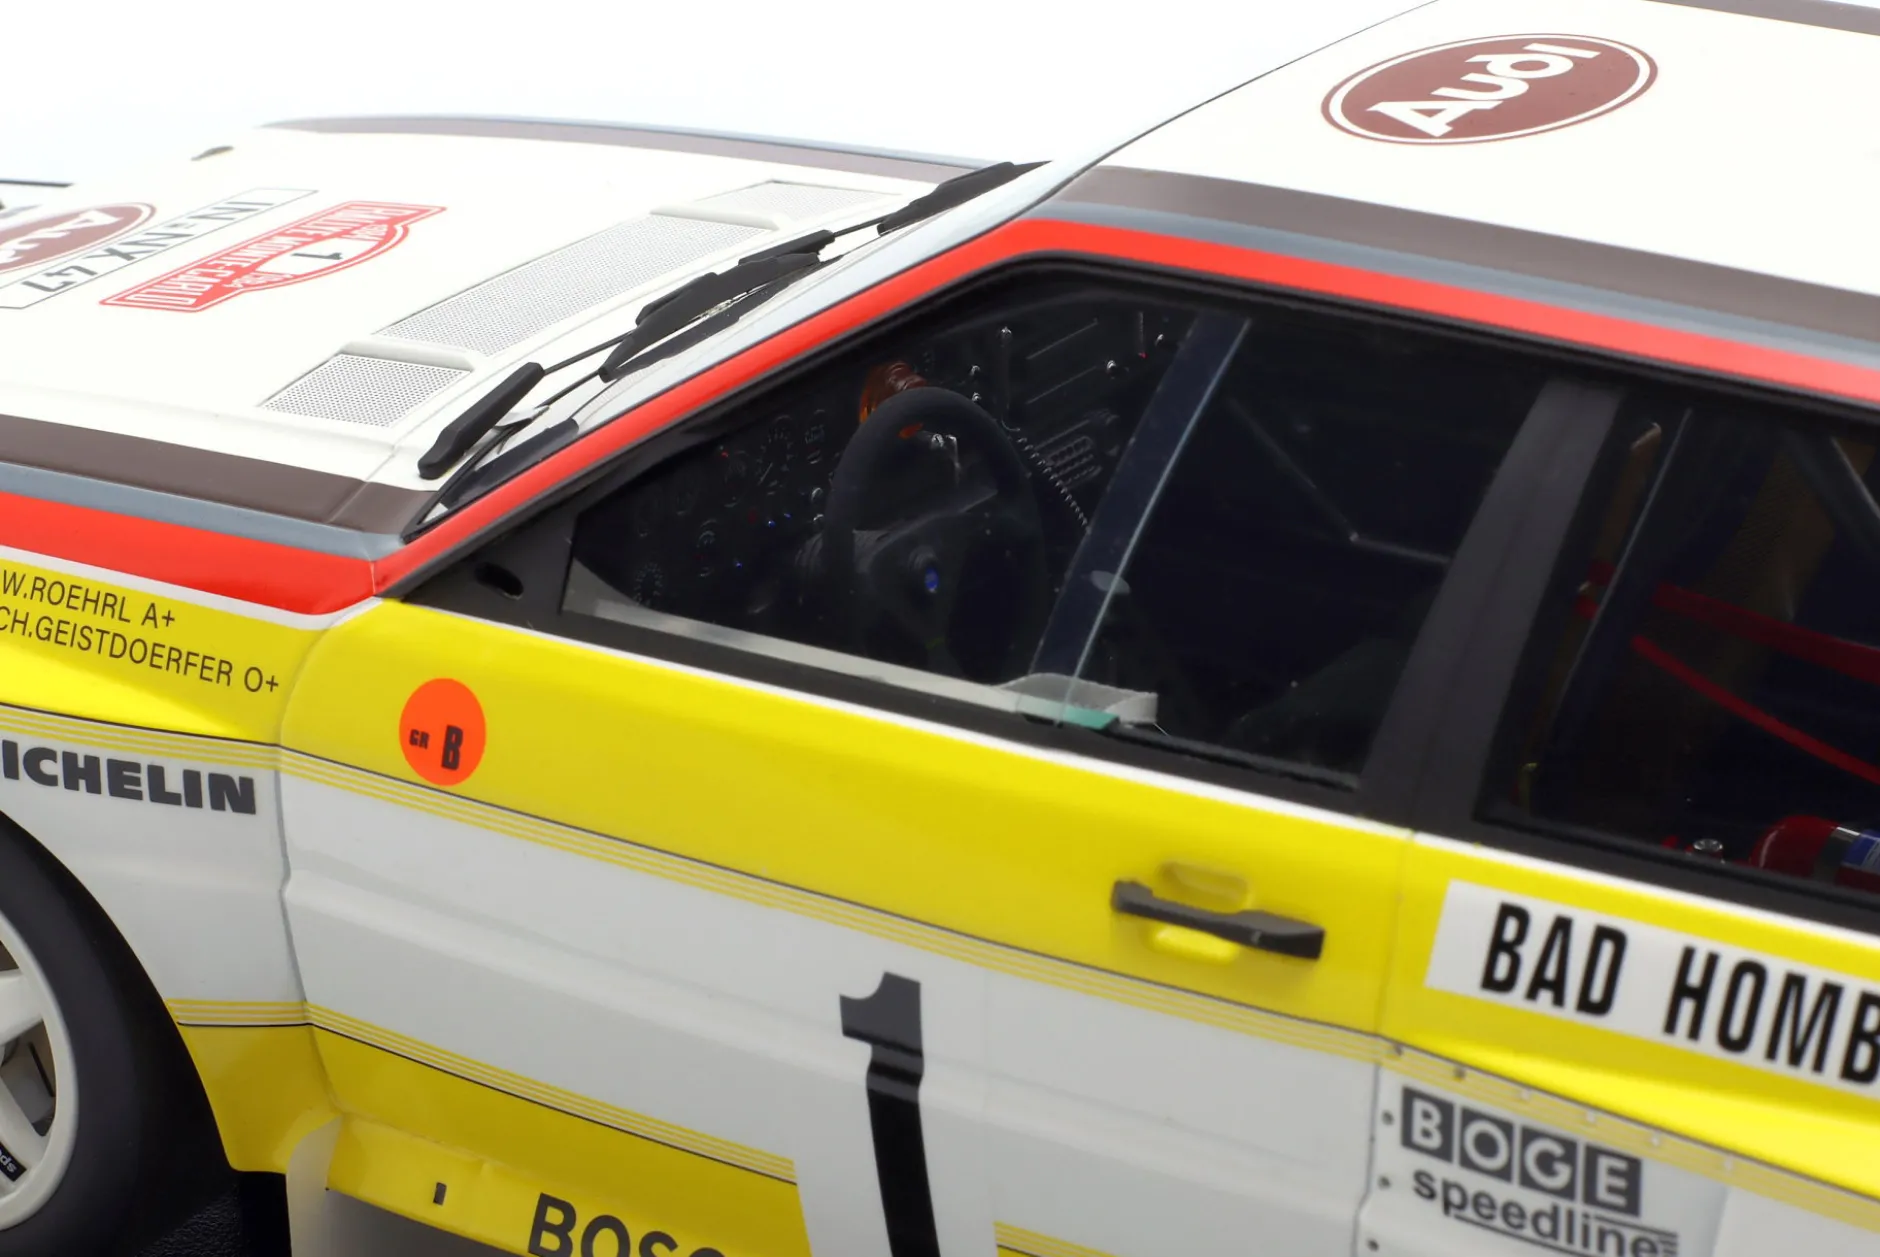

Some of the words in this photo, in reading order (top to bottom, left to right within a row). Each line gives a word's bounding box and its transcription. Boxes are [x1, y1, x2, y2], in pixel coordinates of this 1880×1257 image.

[1366, 43, 1602, 137] Audi
[21, 265, 98, 292] 47
[291, 252, 343, 261] 1
[2, 569, 131, 623] W.ROEHRL
[141, 602, 176, 629] A+
[409, 729, 430, 750] GR
[441, 724, 463, 771] B
[1480, 902, 1628, 1017] BAD
[1408, 1096, 1631, 1209] BOGE
[1412, 1168, 1662, 1257] speedline
